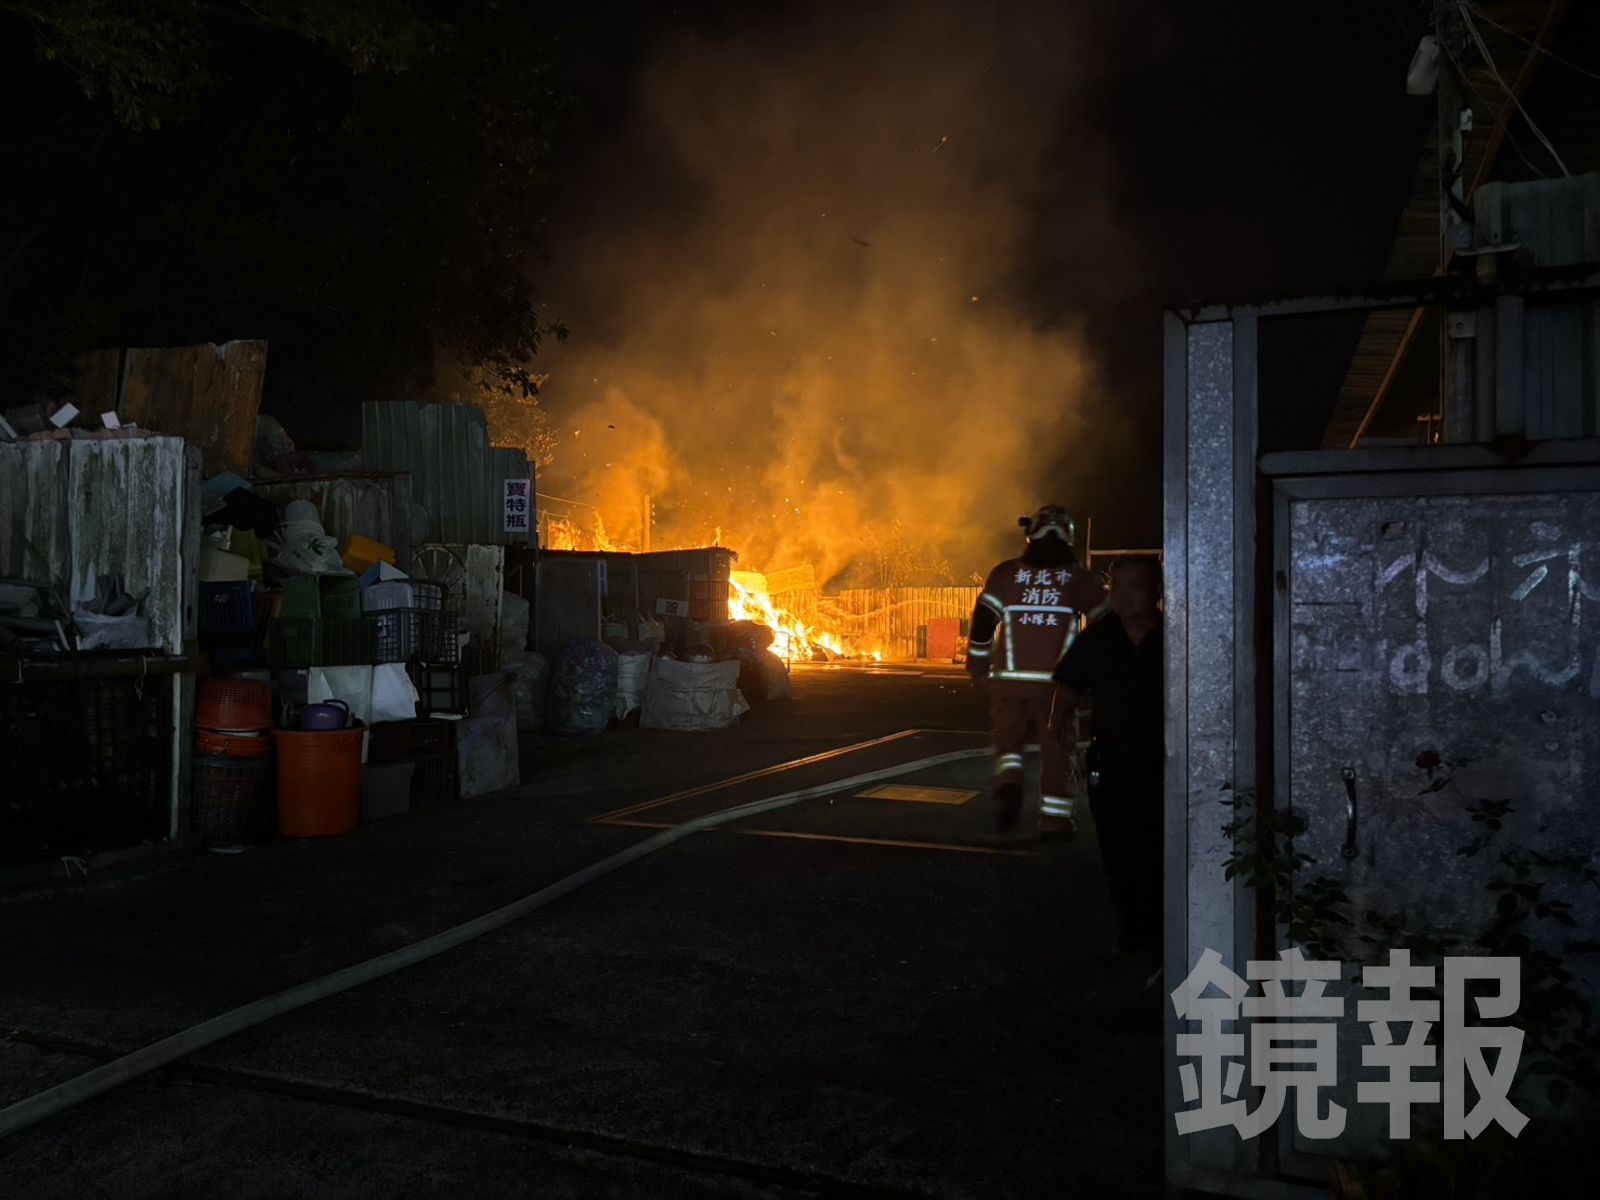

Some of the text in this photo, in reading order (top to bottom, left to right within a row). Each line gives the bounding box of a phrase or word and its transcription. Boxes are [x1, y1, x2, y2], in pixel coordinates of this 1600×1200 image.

[506, 482, 527, 528] 寶特瓶
[1014, 568, 1072, 585] 新北市
[1022, 587, 1061, 605] 消防
[1019, 613, 1058, 626] 小隊長
